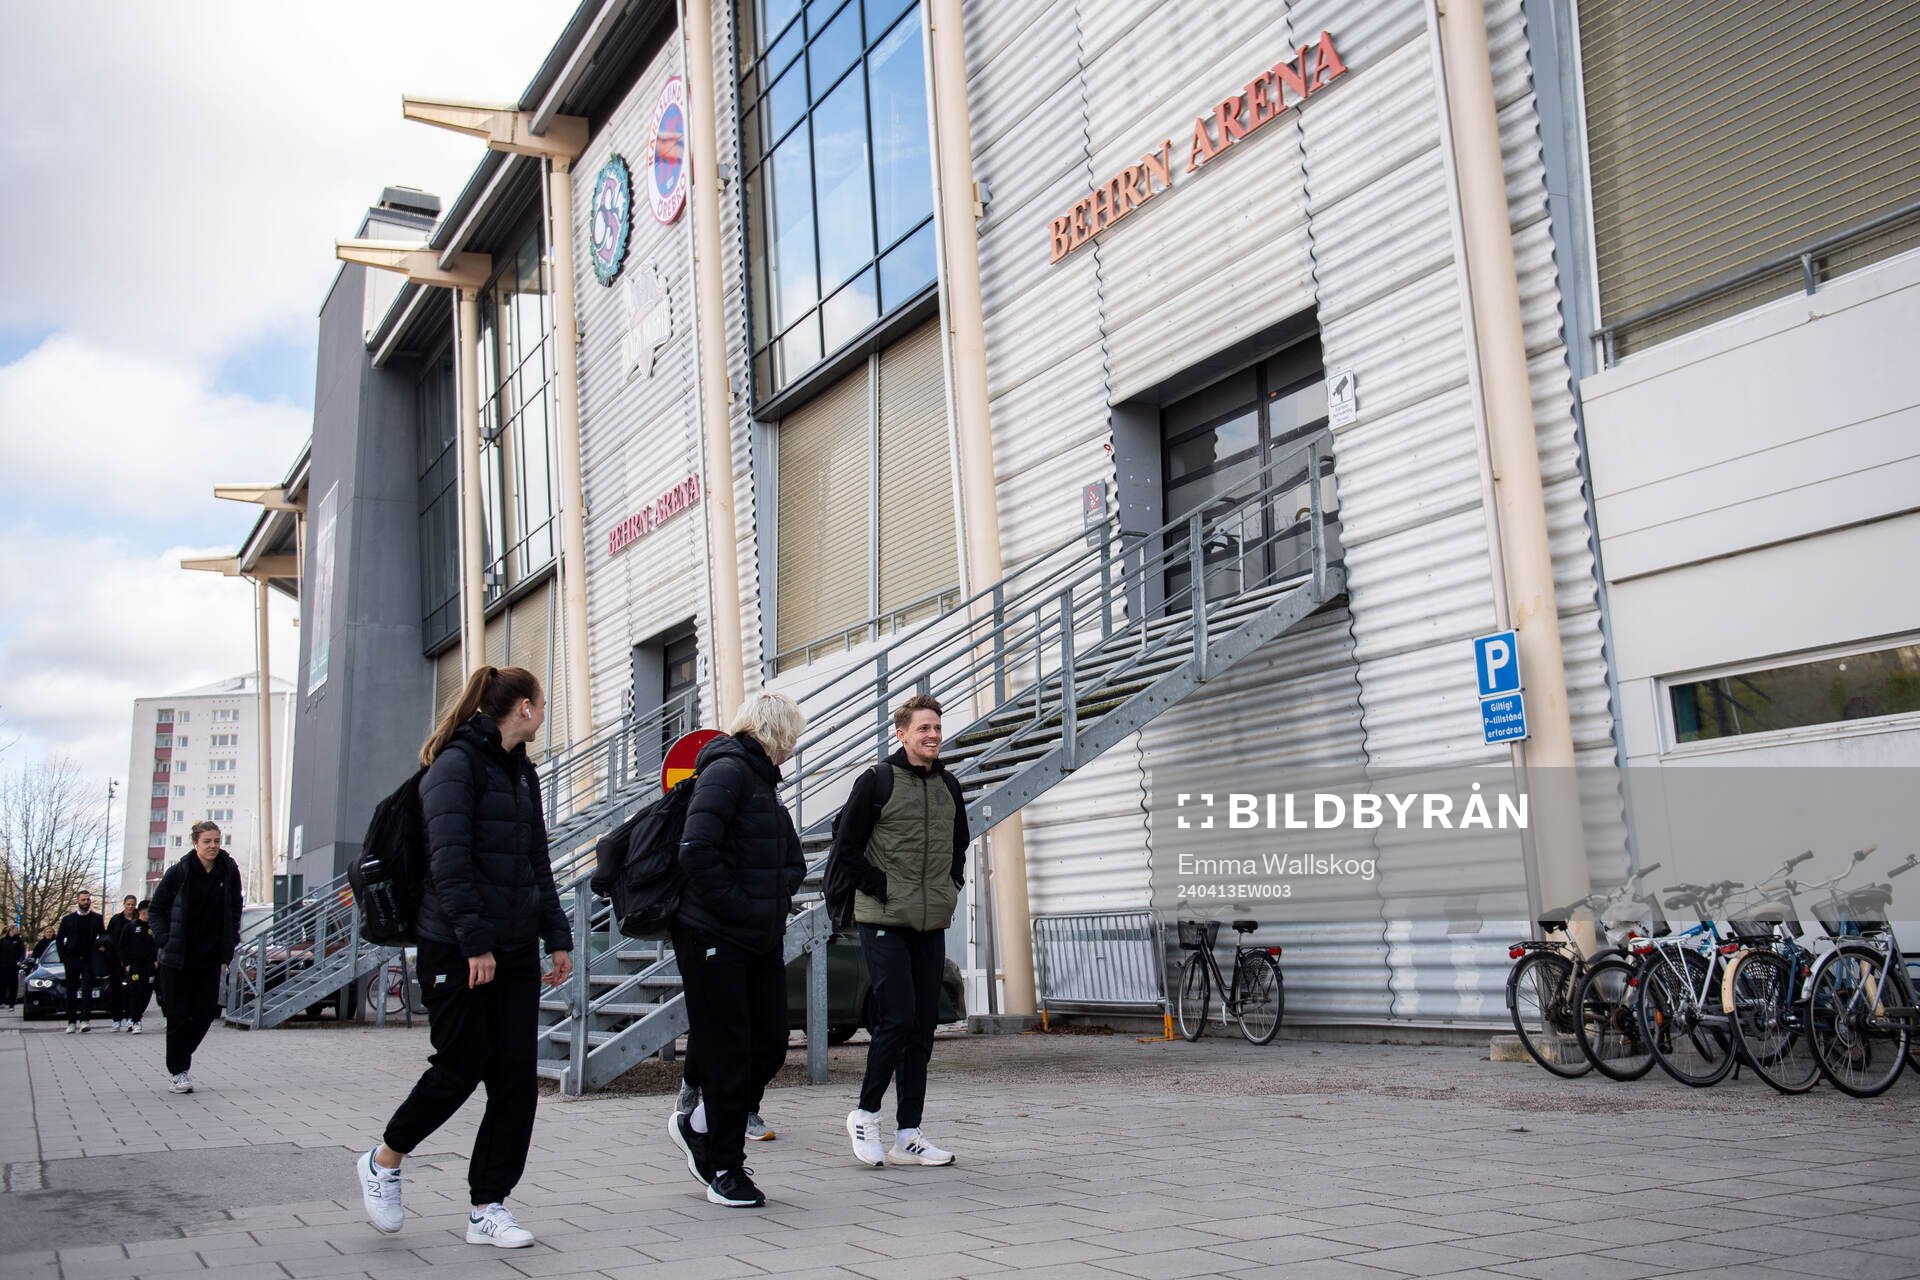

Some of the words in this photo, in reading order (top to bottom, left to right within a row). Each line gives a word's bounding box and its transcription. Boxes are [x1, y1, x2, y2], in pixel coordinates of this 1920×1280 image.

[1048, 138, 1173, 265] BEHRN
[1186, 30, 1349, 174] ARENA
[607, 505, 651, 557] BEHRN
[655, 472, 700, 528] ARENA
[1485, 639, 1510, 690] P
[1491, 700, 1512, 711] Giltigt
[1484, 712, 1522, 726] P-tillstånd
[1488, 726, 1522, 738] erfordras
[367, 1180, 382, 1198] N
[481, 1219, 498, 1237] N
